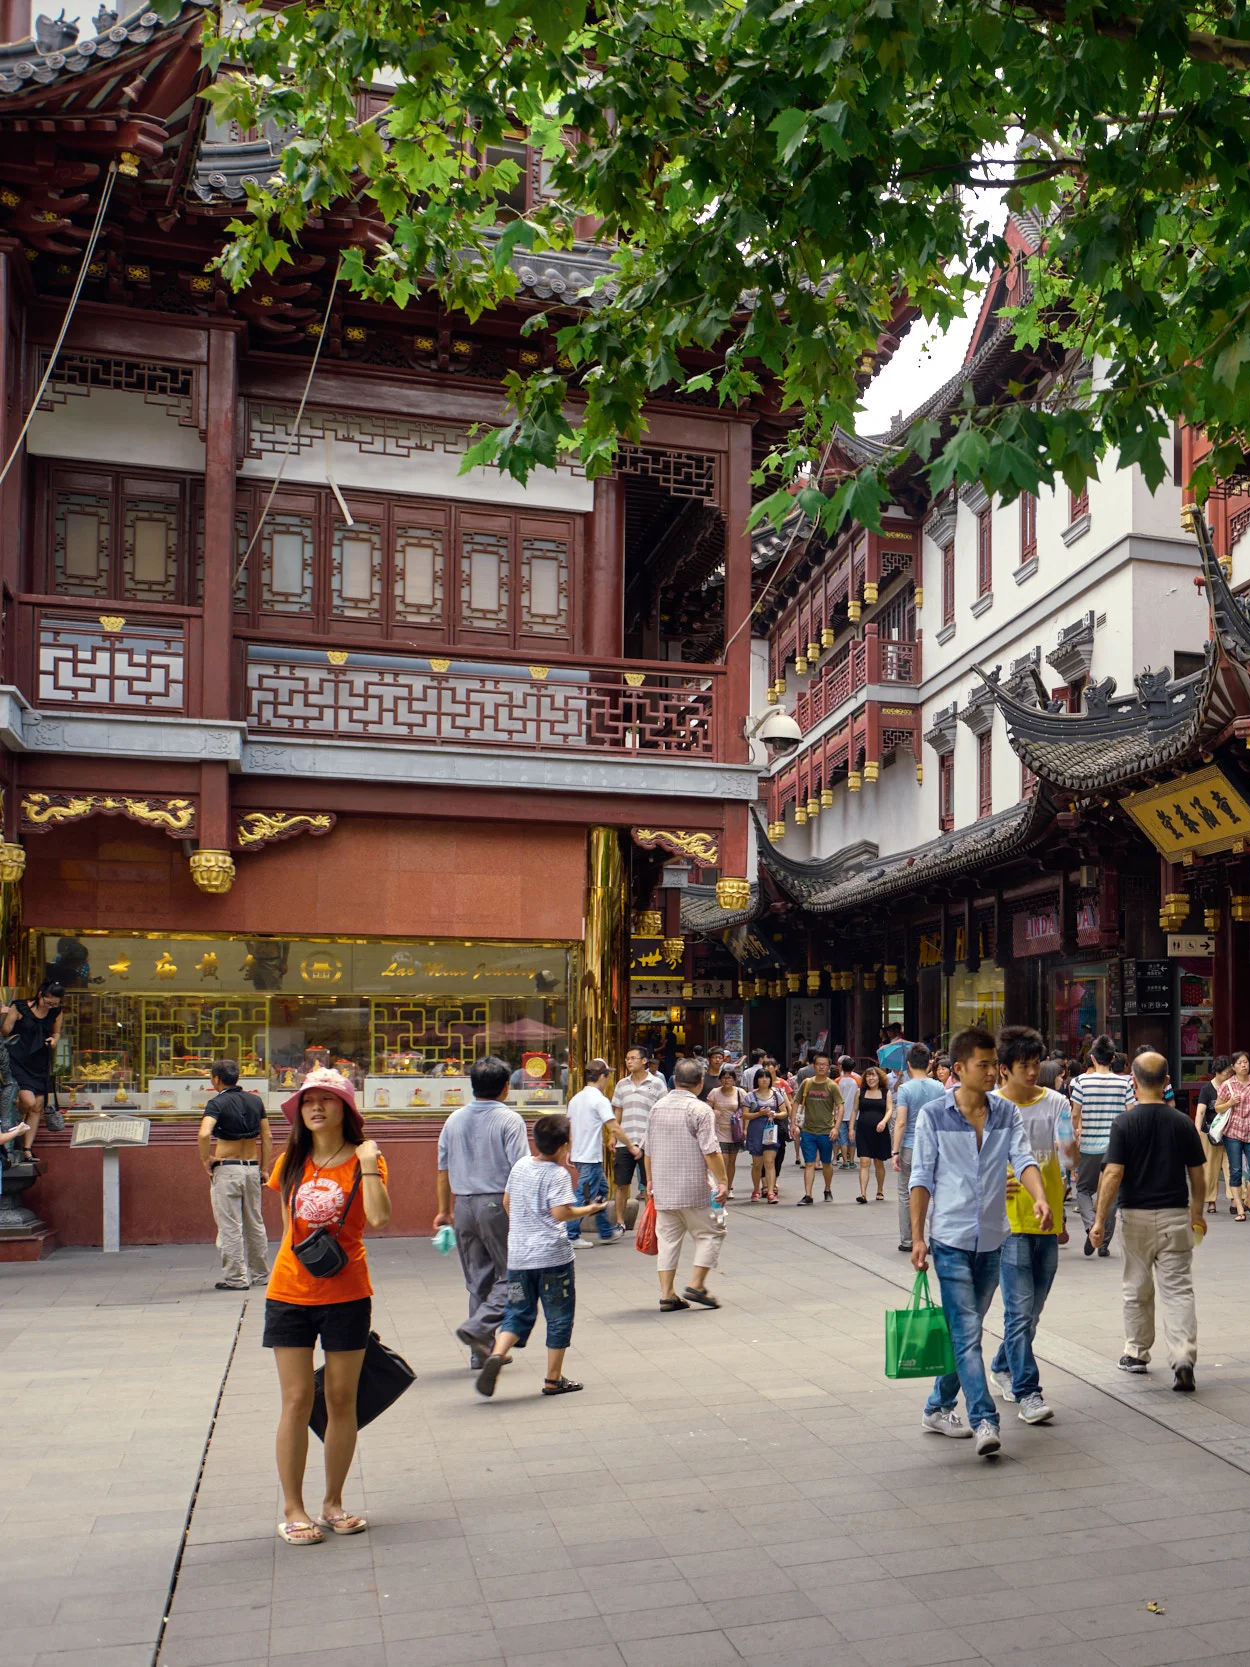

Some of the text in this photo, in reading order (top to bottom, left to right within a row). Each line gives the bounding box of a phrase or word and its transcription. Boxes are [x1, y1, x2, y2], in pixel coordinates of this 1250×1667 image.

[381, 961, 540, 980] Lao Miao Jewelry
